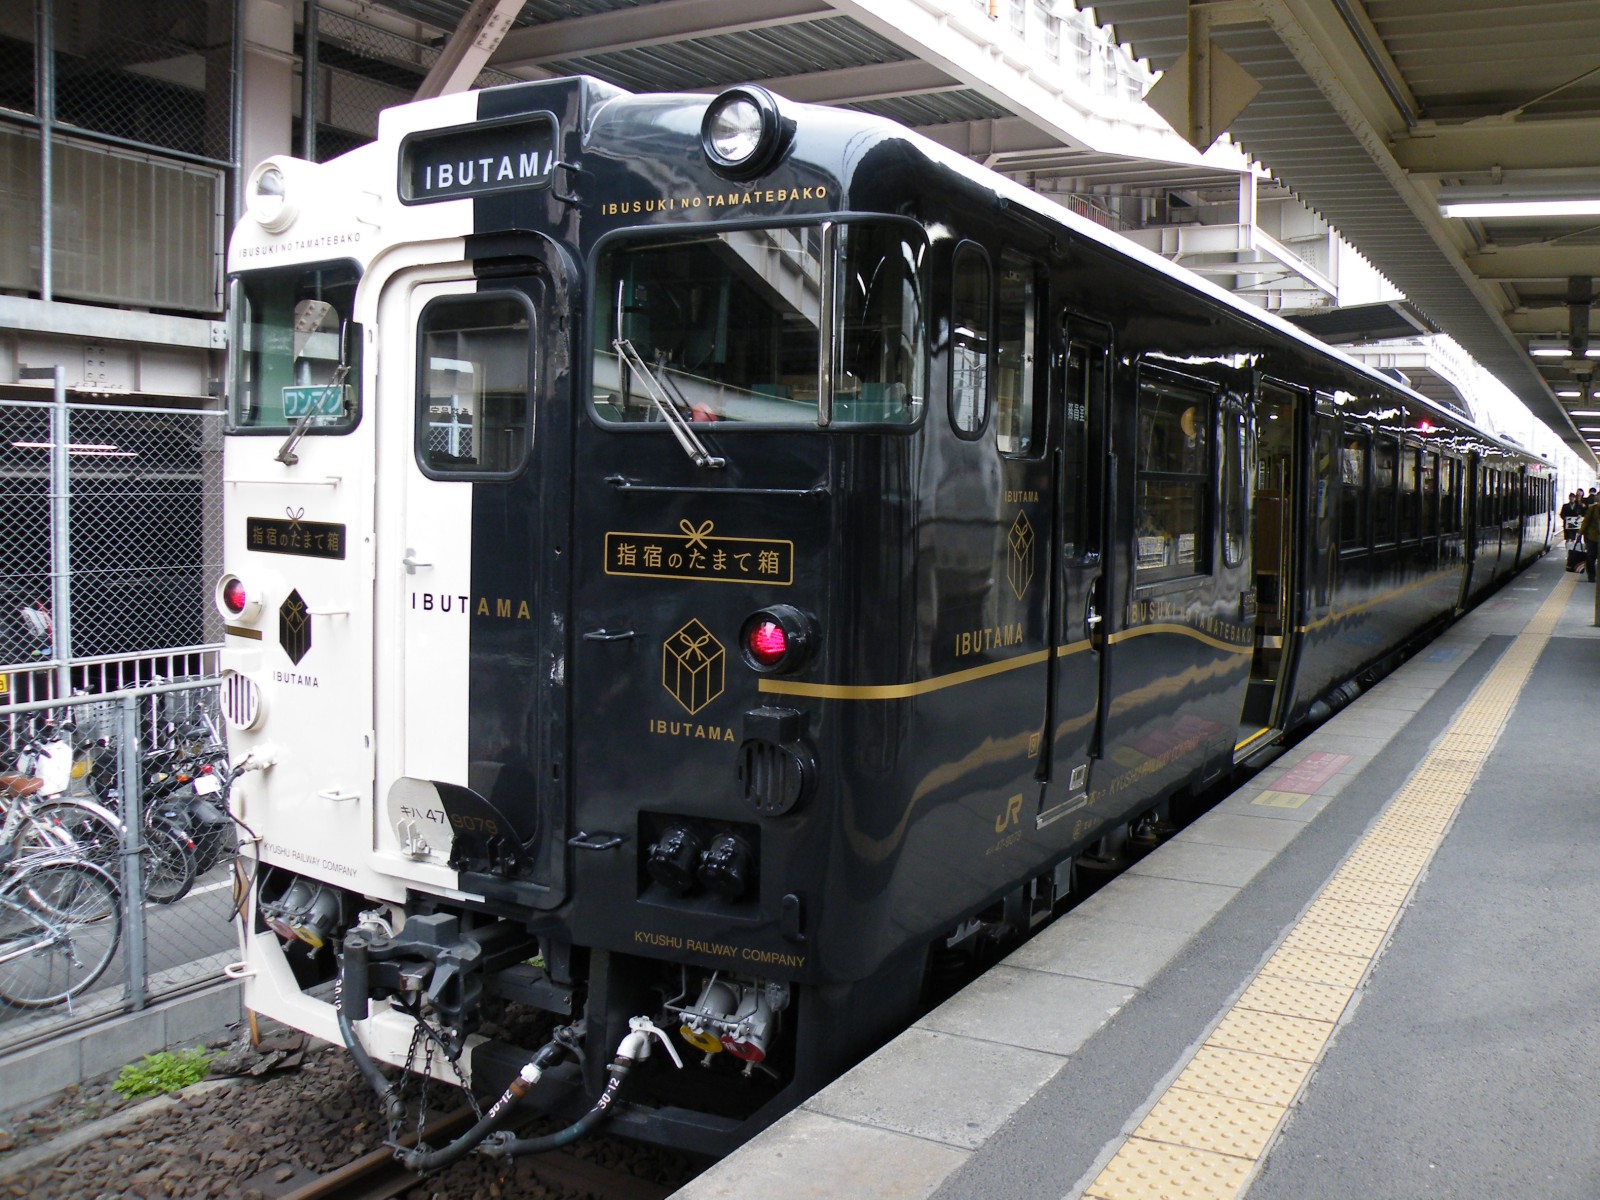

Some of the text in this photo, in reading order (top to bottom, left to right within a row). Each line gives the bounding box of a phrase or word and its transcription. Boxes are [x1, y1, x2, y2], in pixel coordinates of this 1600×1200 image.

[602, 186, 827, 216] IBUSUKI NO TAMATEBAKO
[239, 232, 361, 258] IBUSUKI NO TAMATEBAKO
[285, 390, 341, 415] ワンマン
[1004, 490, 1039, 503] IBUTAMA
[253, 526, 340, 552] 指宿のたまて箱
[617, 543, 780, 575] 指宿のたまて箱
[412, 592, 531, 620] IBUTAMA
[1126, 602, 1176, 625] IBUSUKI
[1195, 610, 1252, 643] TAMATEBAKO
[956, 623, 1023, 657] IBUTAMA
[273, 671, 319, 688] IBUTAMA
[650, 720, 735, 742] IBUTAMA
[451, 813, 498, 838] 9079
[995, 793, 1023, 833] JR
[263, 842, 358, 878] KYUSHU RAILWAY COMPANY
[634, 931, 806, 967] KYUSHU RAILWAY COMPANY
